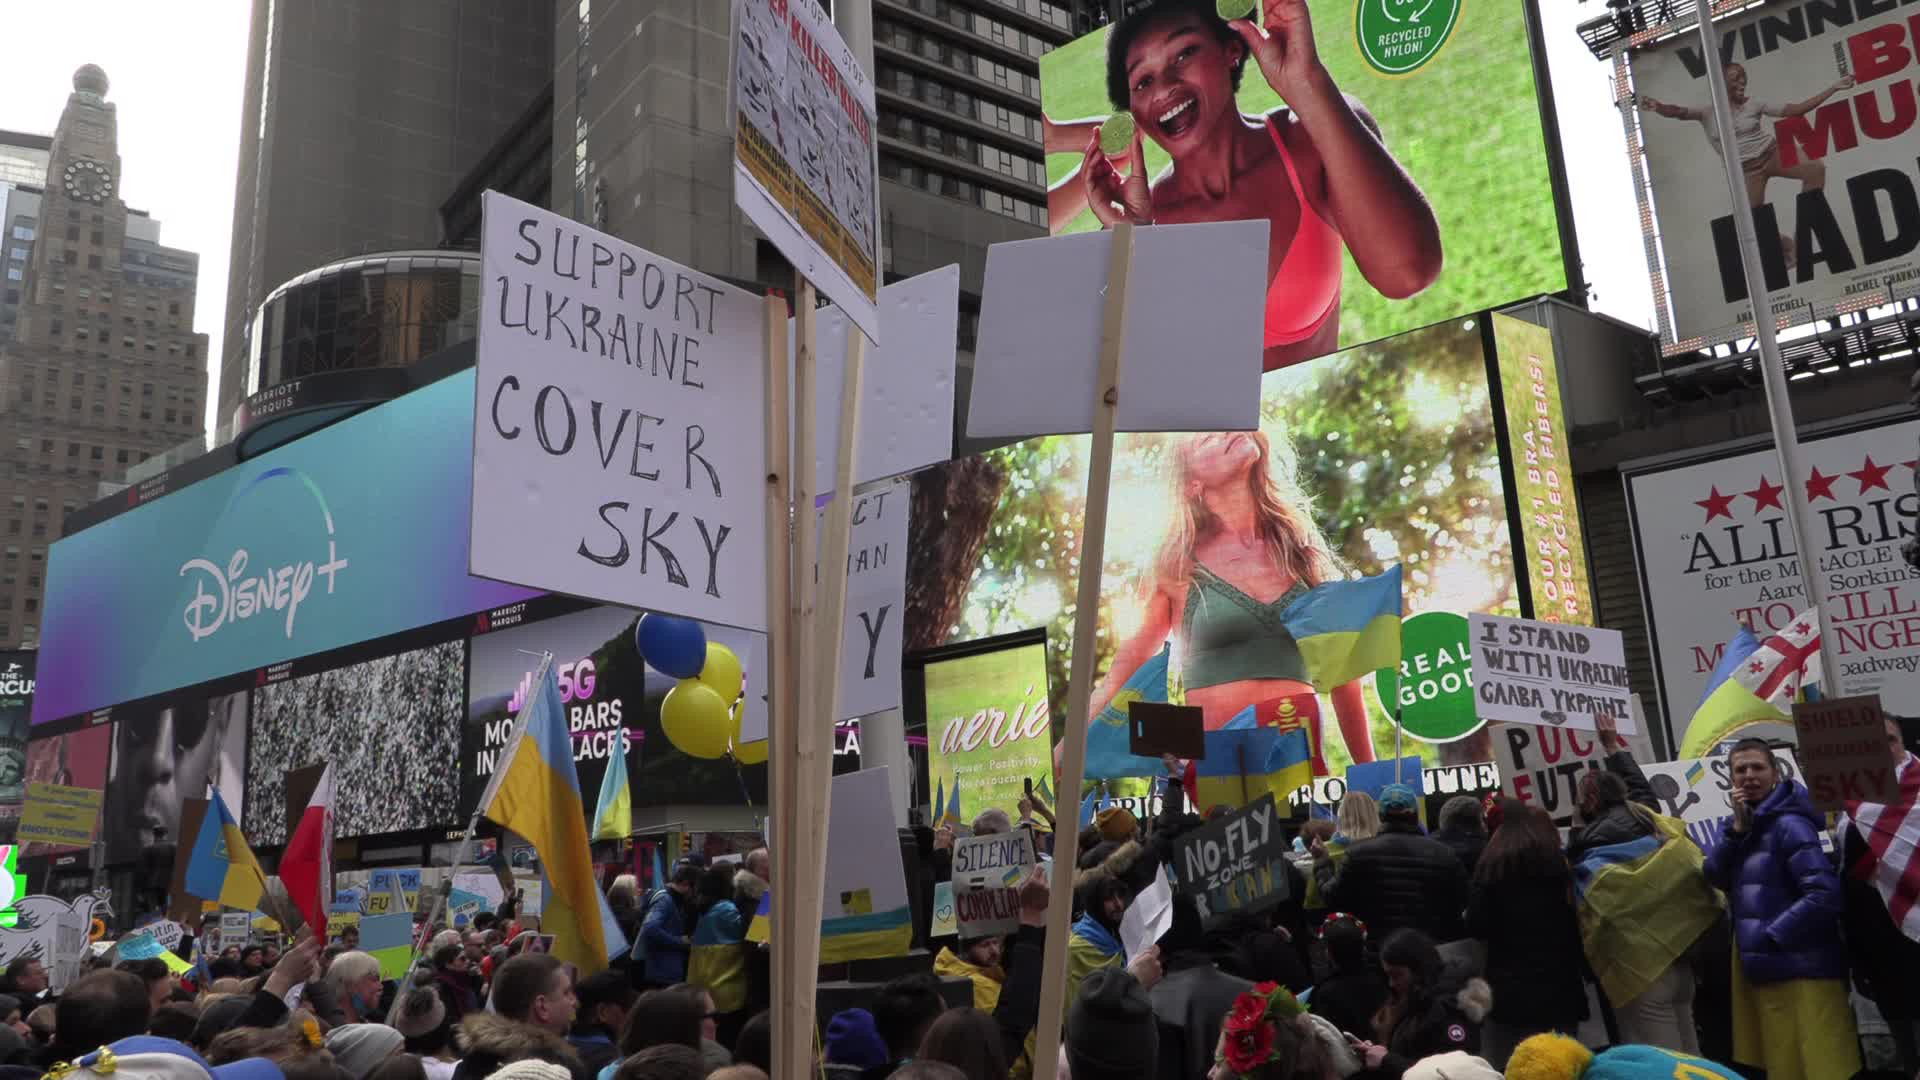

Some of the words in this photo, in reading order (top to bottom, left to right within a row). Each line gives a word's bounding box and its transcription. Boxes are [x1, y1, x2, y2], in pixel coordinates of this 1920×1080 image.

[1377, 25, 1432, 47] RECYCLED
[1384, 40, 1423, 58] NYLON!
[842, 48, 864, 87] STOP
[1774, 79, 1920, 169] MU
[1711, 157, 1920, 304] HAD
[514, 218, 725, 335] SUPPORT
[497, 275, 704, 389] UKRAINE
[1528, 354, 1555, 459] FIBERS!
[491, 374, 722, 498] COVER
[1535, 497, 1550, 529] #1
[577, 501, 732, 599] SKY
[1546, 467, 1579, 615] RECYCLED
[1537, 538, 1559, 601] OUR
[1704, 571, 1733, 590] for
[1738, 567, 1772, 585] the
[1777, 545, 1894, 579] MACLE
[491, 603, 526, 618] MARRIOTT
[1757, 583, 1805, 602] Aar
[1827, 586, 1917, 623] ILL
[491, 615, 522, 628] MARQUIS
[1480, 622, 1498, 643] I
[1507, 623, 1591, 655] STAND
[1, 672, 18, 680] THE
[558, 658, 596, 704] 5G
[1480, 647, 1553, 678] WITH
[1557, 655, 1630, 688] UKRAINE
[570, 698, 623, 733] BARS
[940, 684, 1050, 757] aerie
[1799, 705, 1877, 732] SHIELD
[1815, 767, 1889, 802] SKY
[955, 837, 1028, 873] SILENCE
[1206, 855, 1255, 890] ZONE
